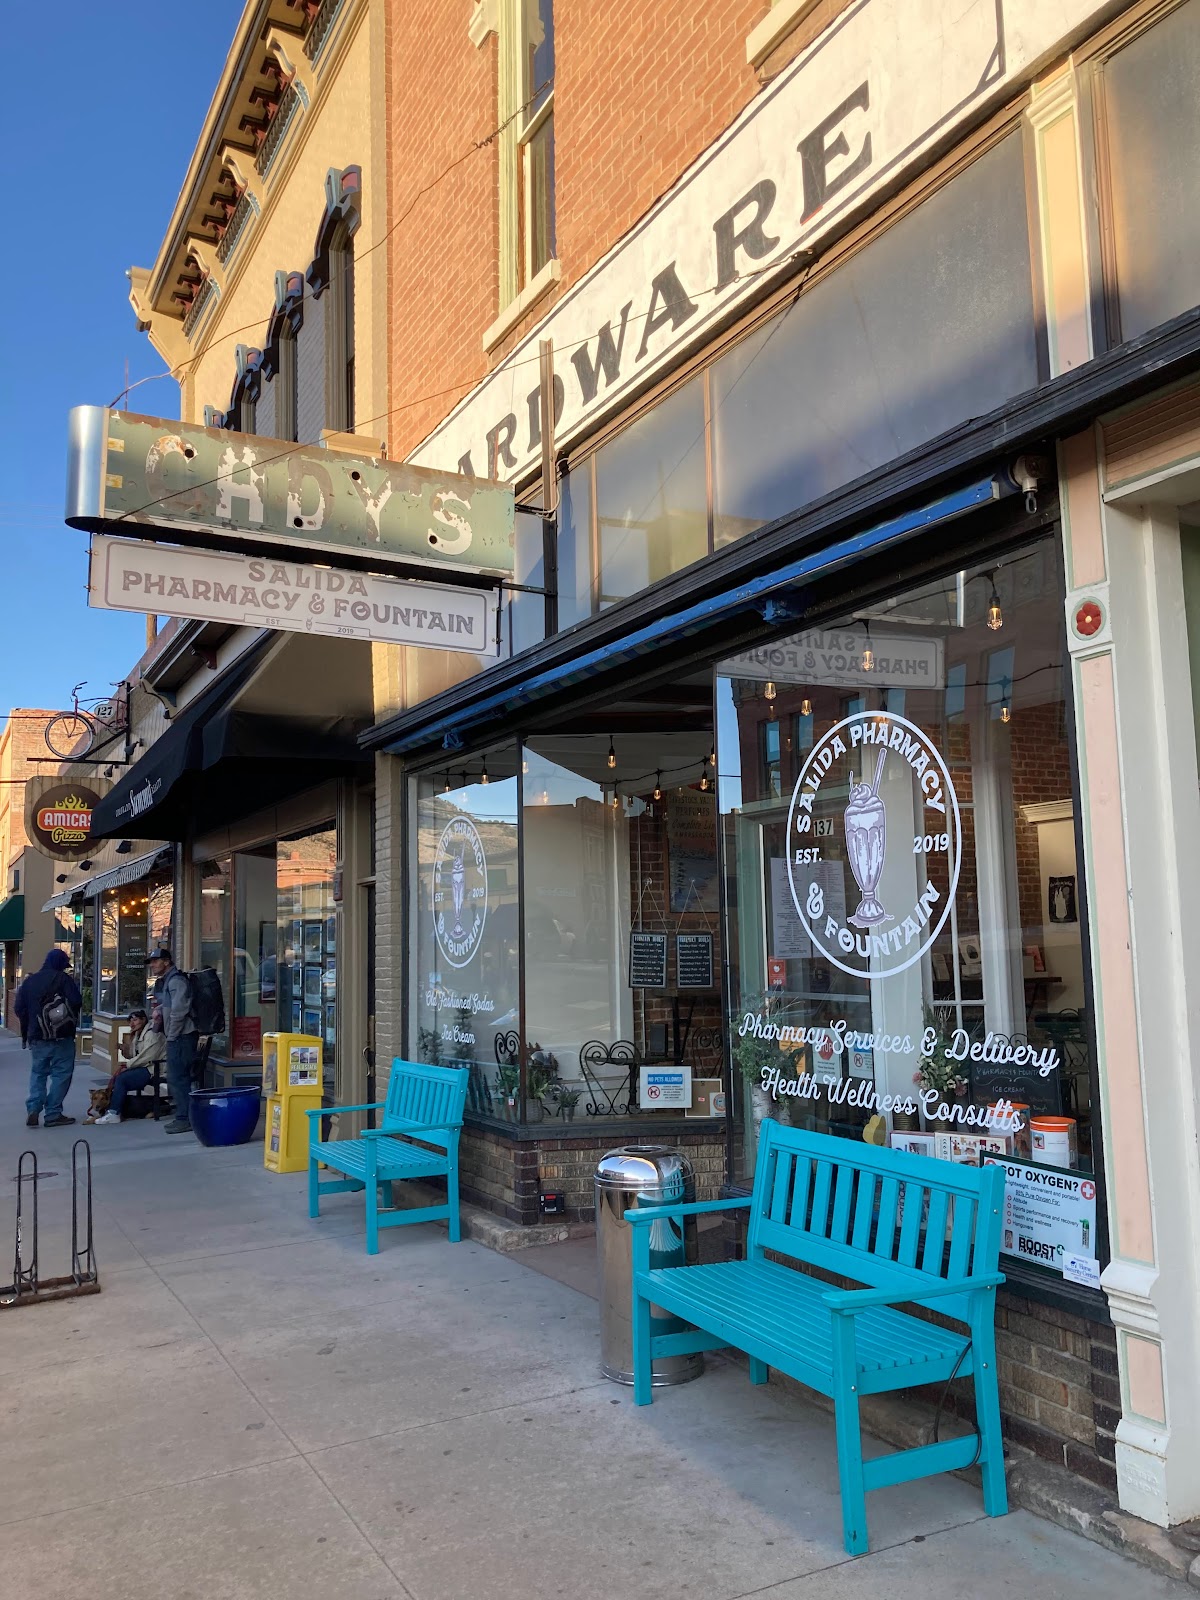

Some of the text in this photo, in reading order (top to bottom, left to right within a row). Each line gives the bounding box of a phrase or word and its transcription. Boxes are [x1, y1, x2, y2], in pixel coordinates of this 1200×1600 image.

[248, 561, 369, 597] SALIDA
[122, 569, 474, 635] PHARMACY & FOUNTAIN
[337, 626, 354, 635] 2019
[97, 706, 113, 716] 127
[797, 722, 946, 833] SALIDA PHARMACY
[52, 827, 86, 843] Pizza
[814, 819, 833, 836] 137
[453, 822, 484, 877] PHARMACY
[795, 833, 950, 865] EST. 2019
[472, 887, 485, 898] 2019
[806, 882, 824, 920] &
[824, 879, 941, 958] FOUNTAIN
[443, 913, 481, 956] FOUNTAIN
[425, 990, 495, 1015] Old Fashioned Sodas
[441, 1023, 476, 1044] Ice Cream
[738, 1012, 1061, 1077] Pharmacy Services & Delivery
[1018, 1067, 1041, 1076] FOUNT
[760, 1065, 1025, 1133] Health Wellness Consults
[1003, 1086, 1025, 1094] CREAM
[1025, 1171, 1079, 1192] OXYGEN?
[1013, 1205, 1025, 1213] Sports
[1026, 1208, 1051, 1219] performance
[1061, 1218, 1079, 1227] recovery
[1013, 1213, 1025, 1221] Health
[1035, 1219, 1052, 1228] wellness
[1019, 1237, 1056, 1260] BOOST
